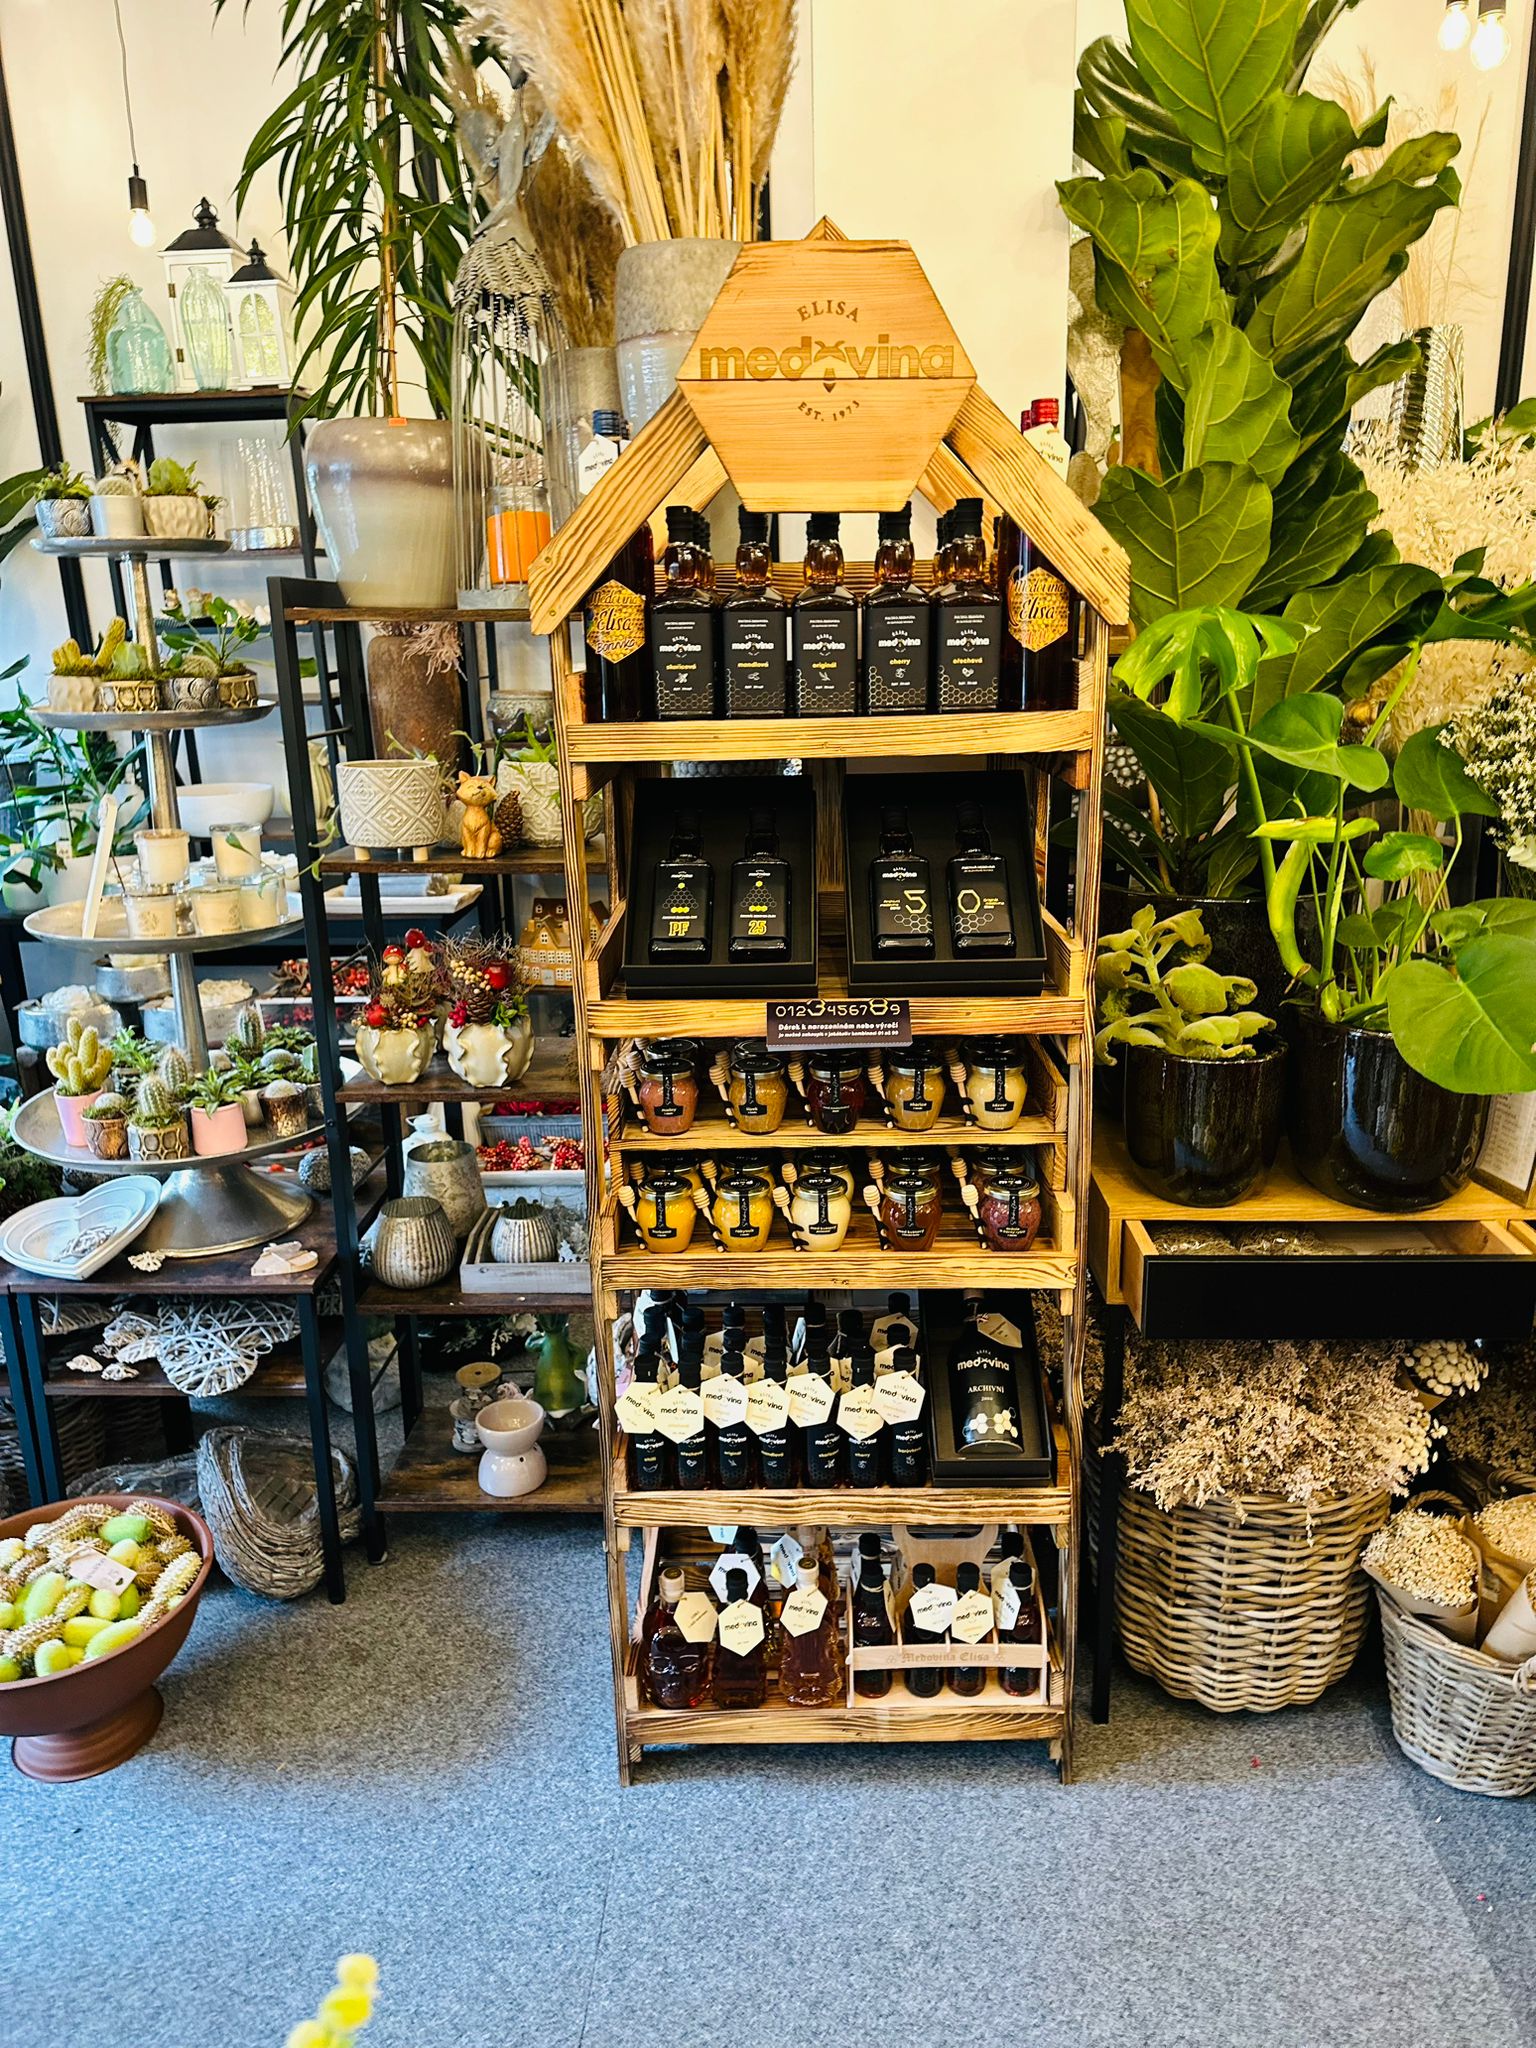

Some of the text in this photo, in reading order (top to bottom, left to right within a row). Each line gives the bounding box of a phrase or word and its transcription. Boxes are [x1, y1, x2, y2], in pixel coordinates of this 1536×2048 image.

[797, 300, 859, 322] ELISA
[798, 400, 860, 422] EST. 1973
[1020, 596, 1055, 620] Elisa
[596, 608, 632, 630] Elisa
[904, 890, 927, 914] 5
[668, 921, 690, 936] PF
[748, 920, 767, 936] 25
[776, 998, 900, 1017] 0123456789
[876, 1022, 898, 1030] výročí
[902, 1651, 990, 1663] Medovina Elisa
